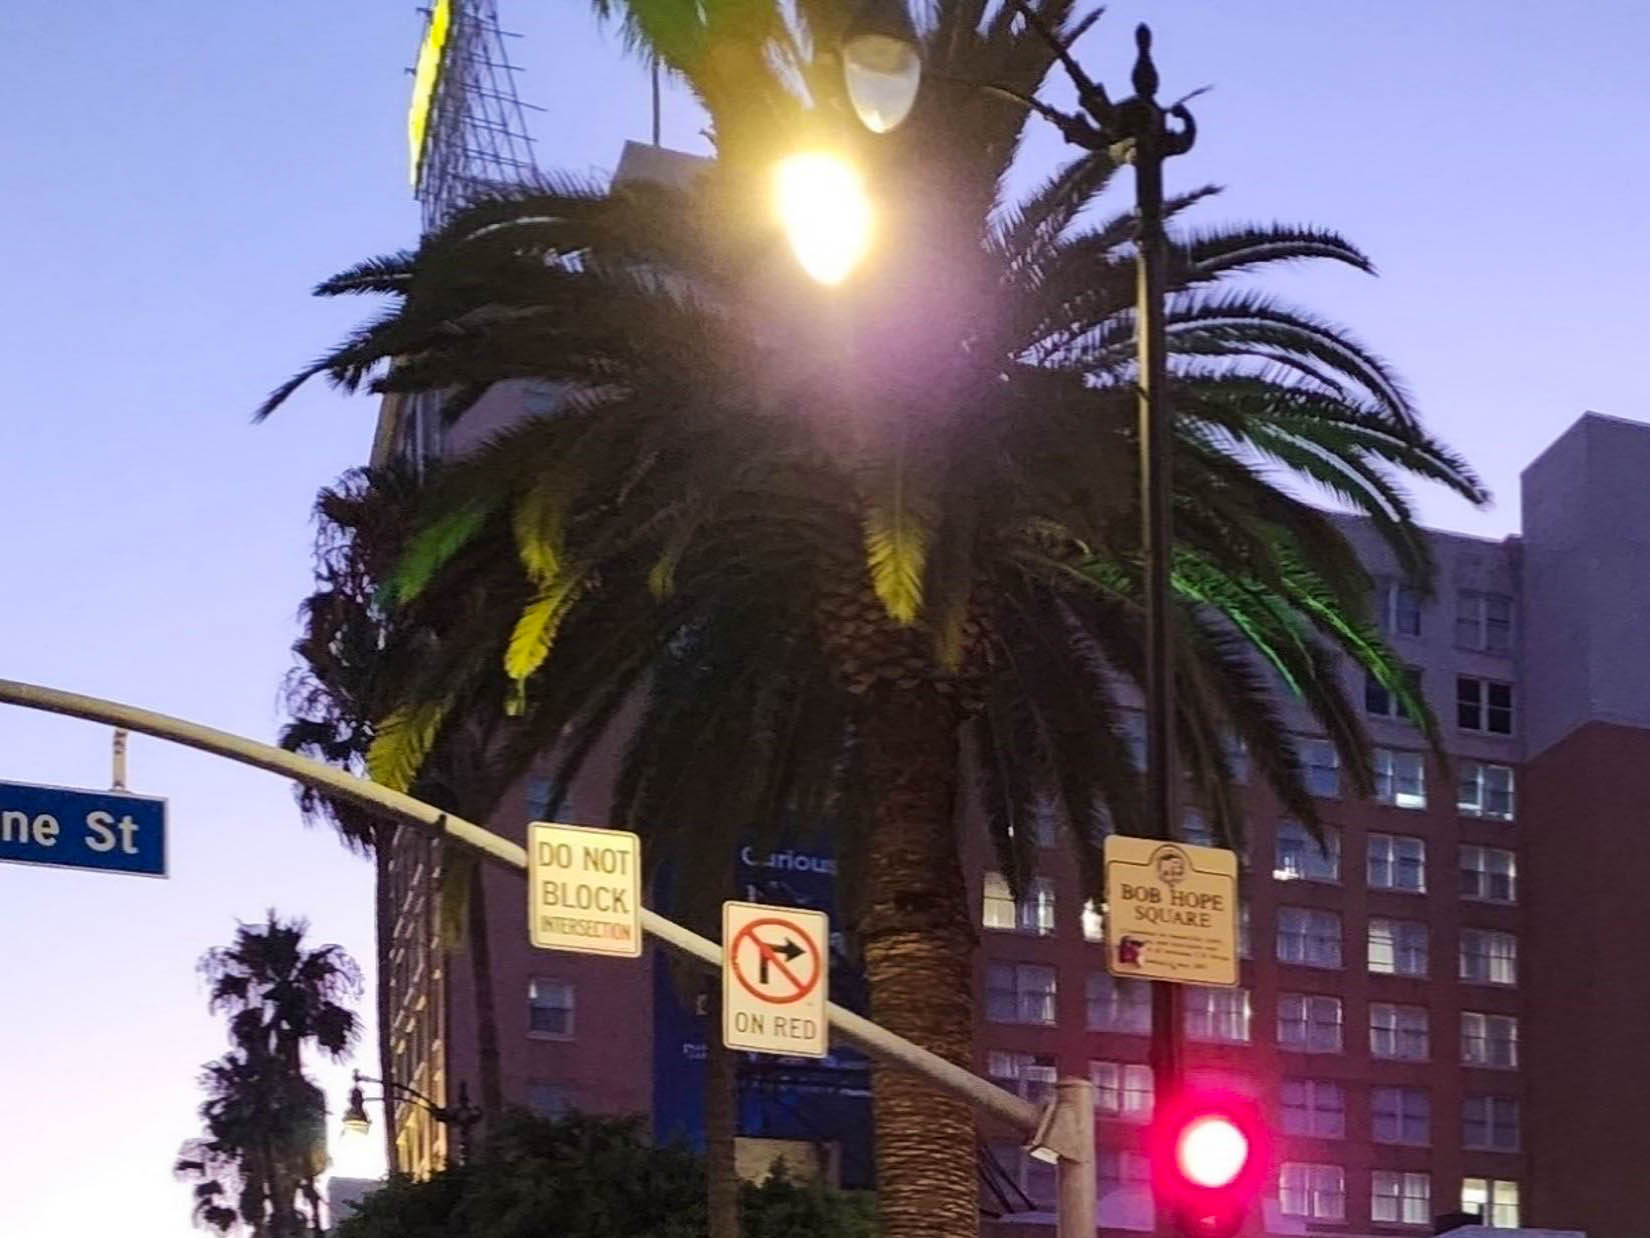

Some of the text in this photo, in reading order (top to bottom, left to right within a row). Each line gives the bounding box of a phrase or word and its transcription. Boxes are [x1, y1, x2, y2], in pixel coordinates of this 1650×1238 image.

[85, 811, 139, 854] St
[538, 841, 631, 875] DO NOT
[543, 881, 630, 914] BLOCK
[1120, 884, 1224, 912] BOB HOPE
[541, 916, 631, 940] INTERSECTION
[1134, 905, 1212, 928] SQUARE
[735, 1012, 817, 1041] ON RED
